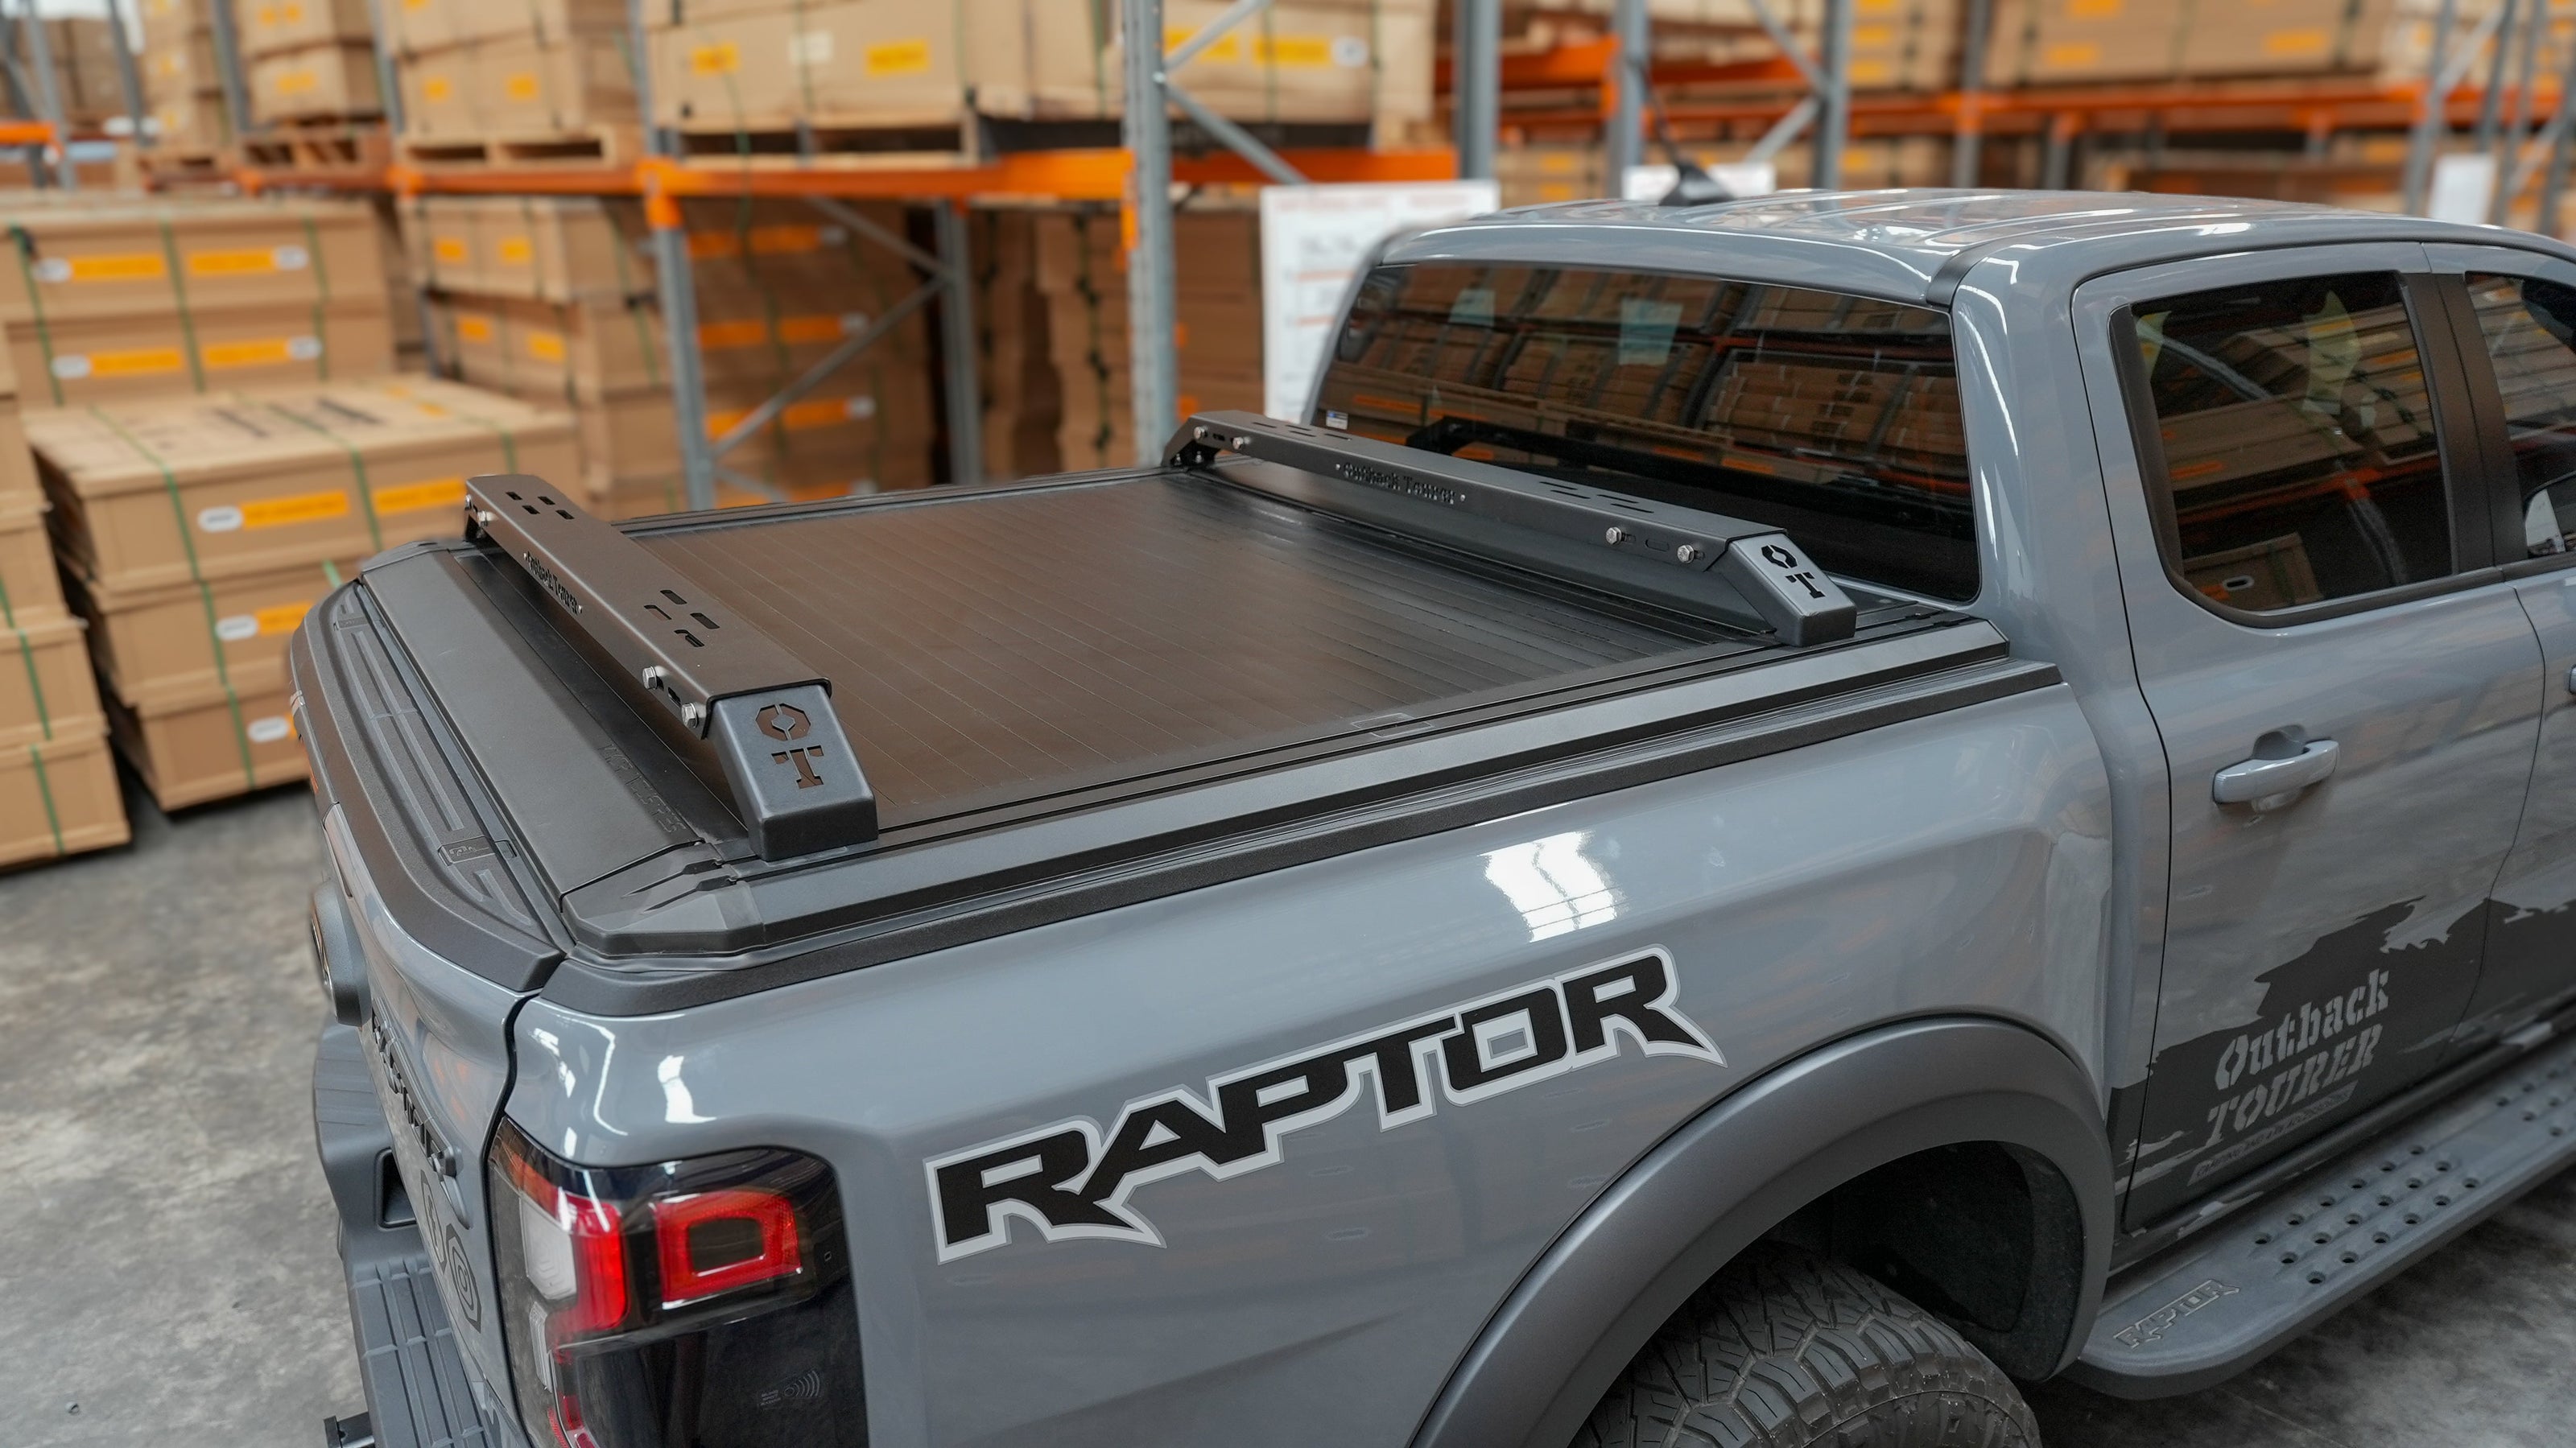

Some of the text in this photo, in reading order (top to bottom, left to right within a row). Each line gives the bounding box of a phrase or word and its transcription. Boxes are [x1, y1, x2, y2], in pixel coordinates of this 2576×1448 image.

[2207, 1023, 2383, 1148] TOURER
[2215, 968, 2389, 1091] Outback
[926, 947, 1723, 1260] RAPTOR
[2112, 1278, 2240, 1350] RAPTOR
